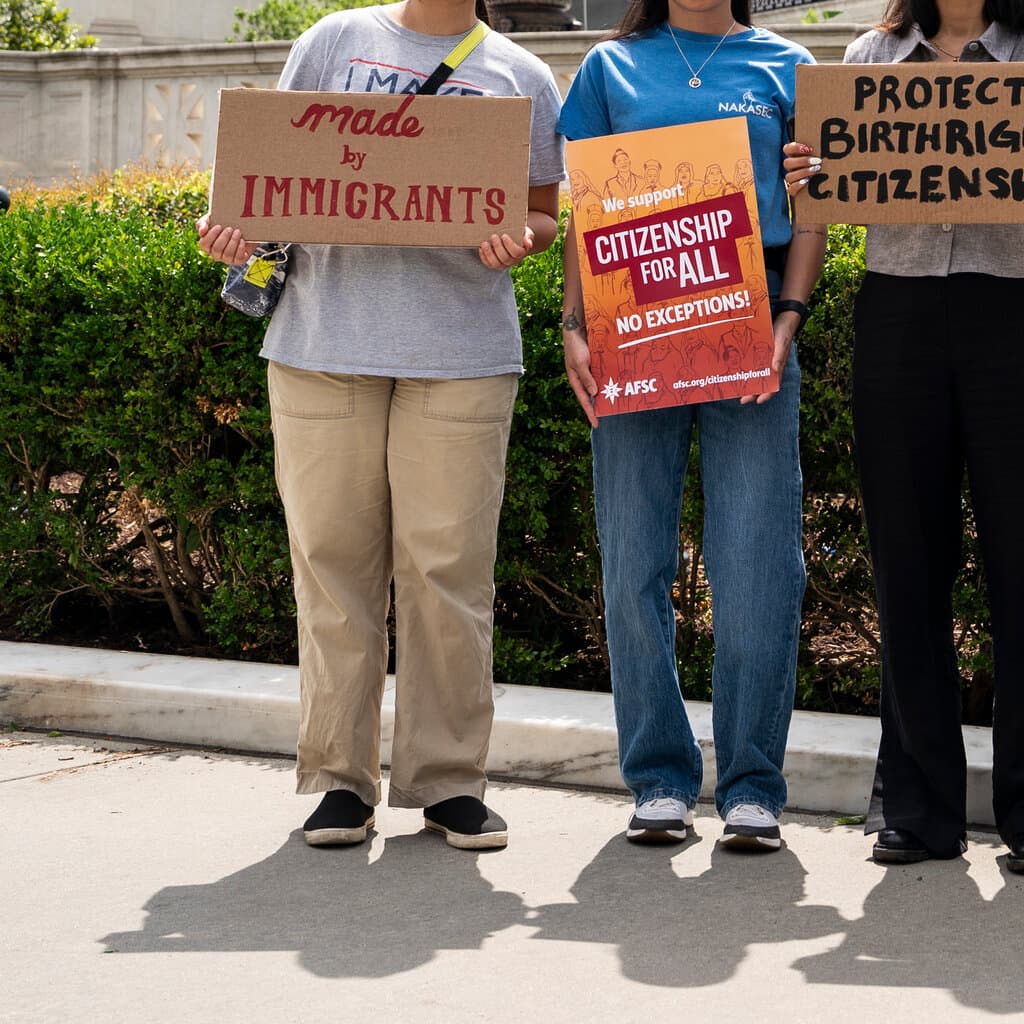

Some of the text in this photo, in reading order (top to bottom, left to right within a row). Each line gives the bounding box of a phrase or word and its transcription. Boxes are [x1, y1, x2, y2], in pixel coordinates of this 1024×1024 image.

[344, 66, 484, 96] I MA
[290, 95, 424, 137] made
[718, 102, 773, 119] NAKASEC
[340, 144, 367, 171] by
[240, 175, 506, 226] IMMIGRANTS
[602, 183, 685, 213] We support
[594, 209, 733, 265] CITIZENSHIP
[640, 245, 730, 288] FOR ALL
[615, 290, 751, 335] NO EXCEPTIONS!
[624, 367, 771, 397] AFSC afsc.org/citizenshipforall
